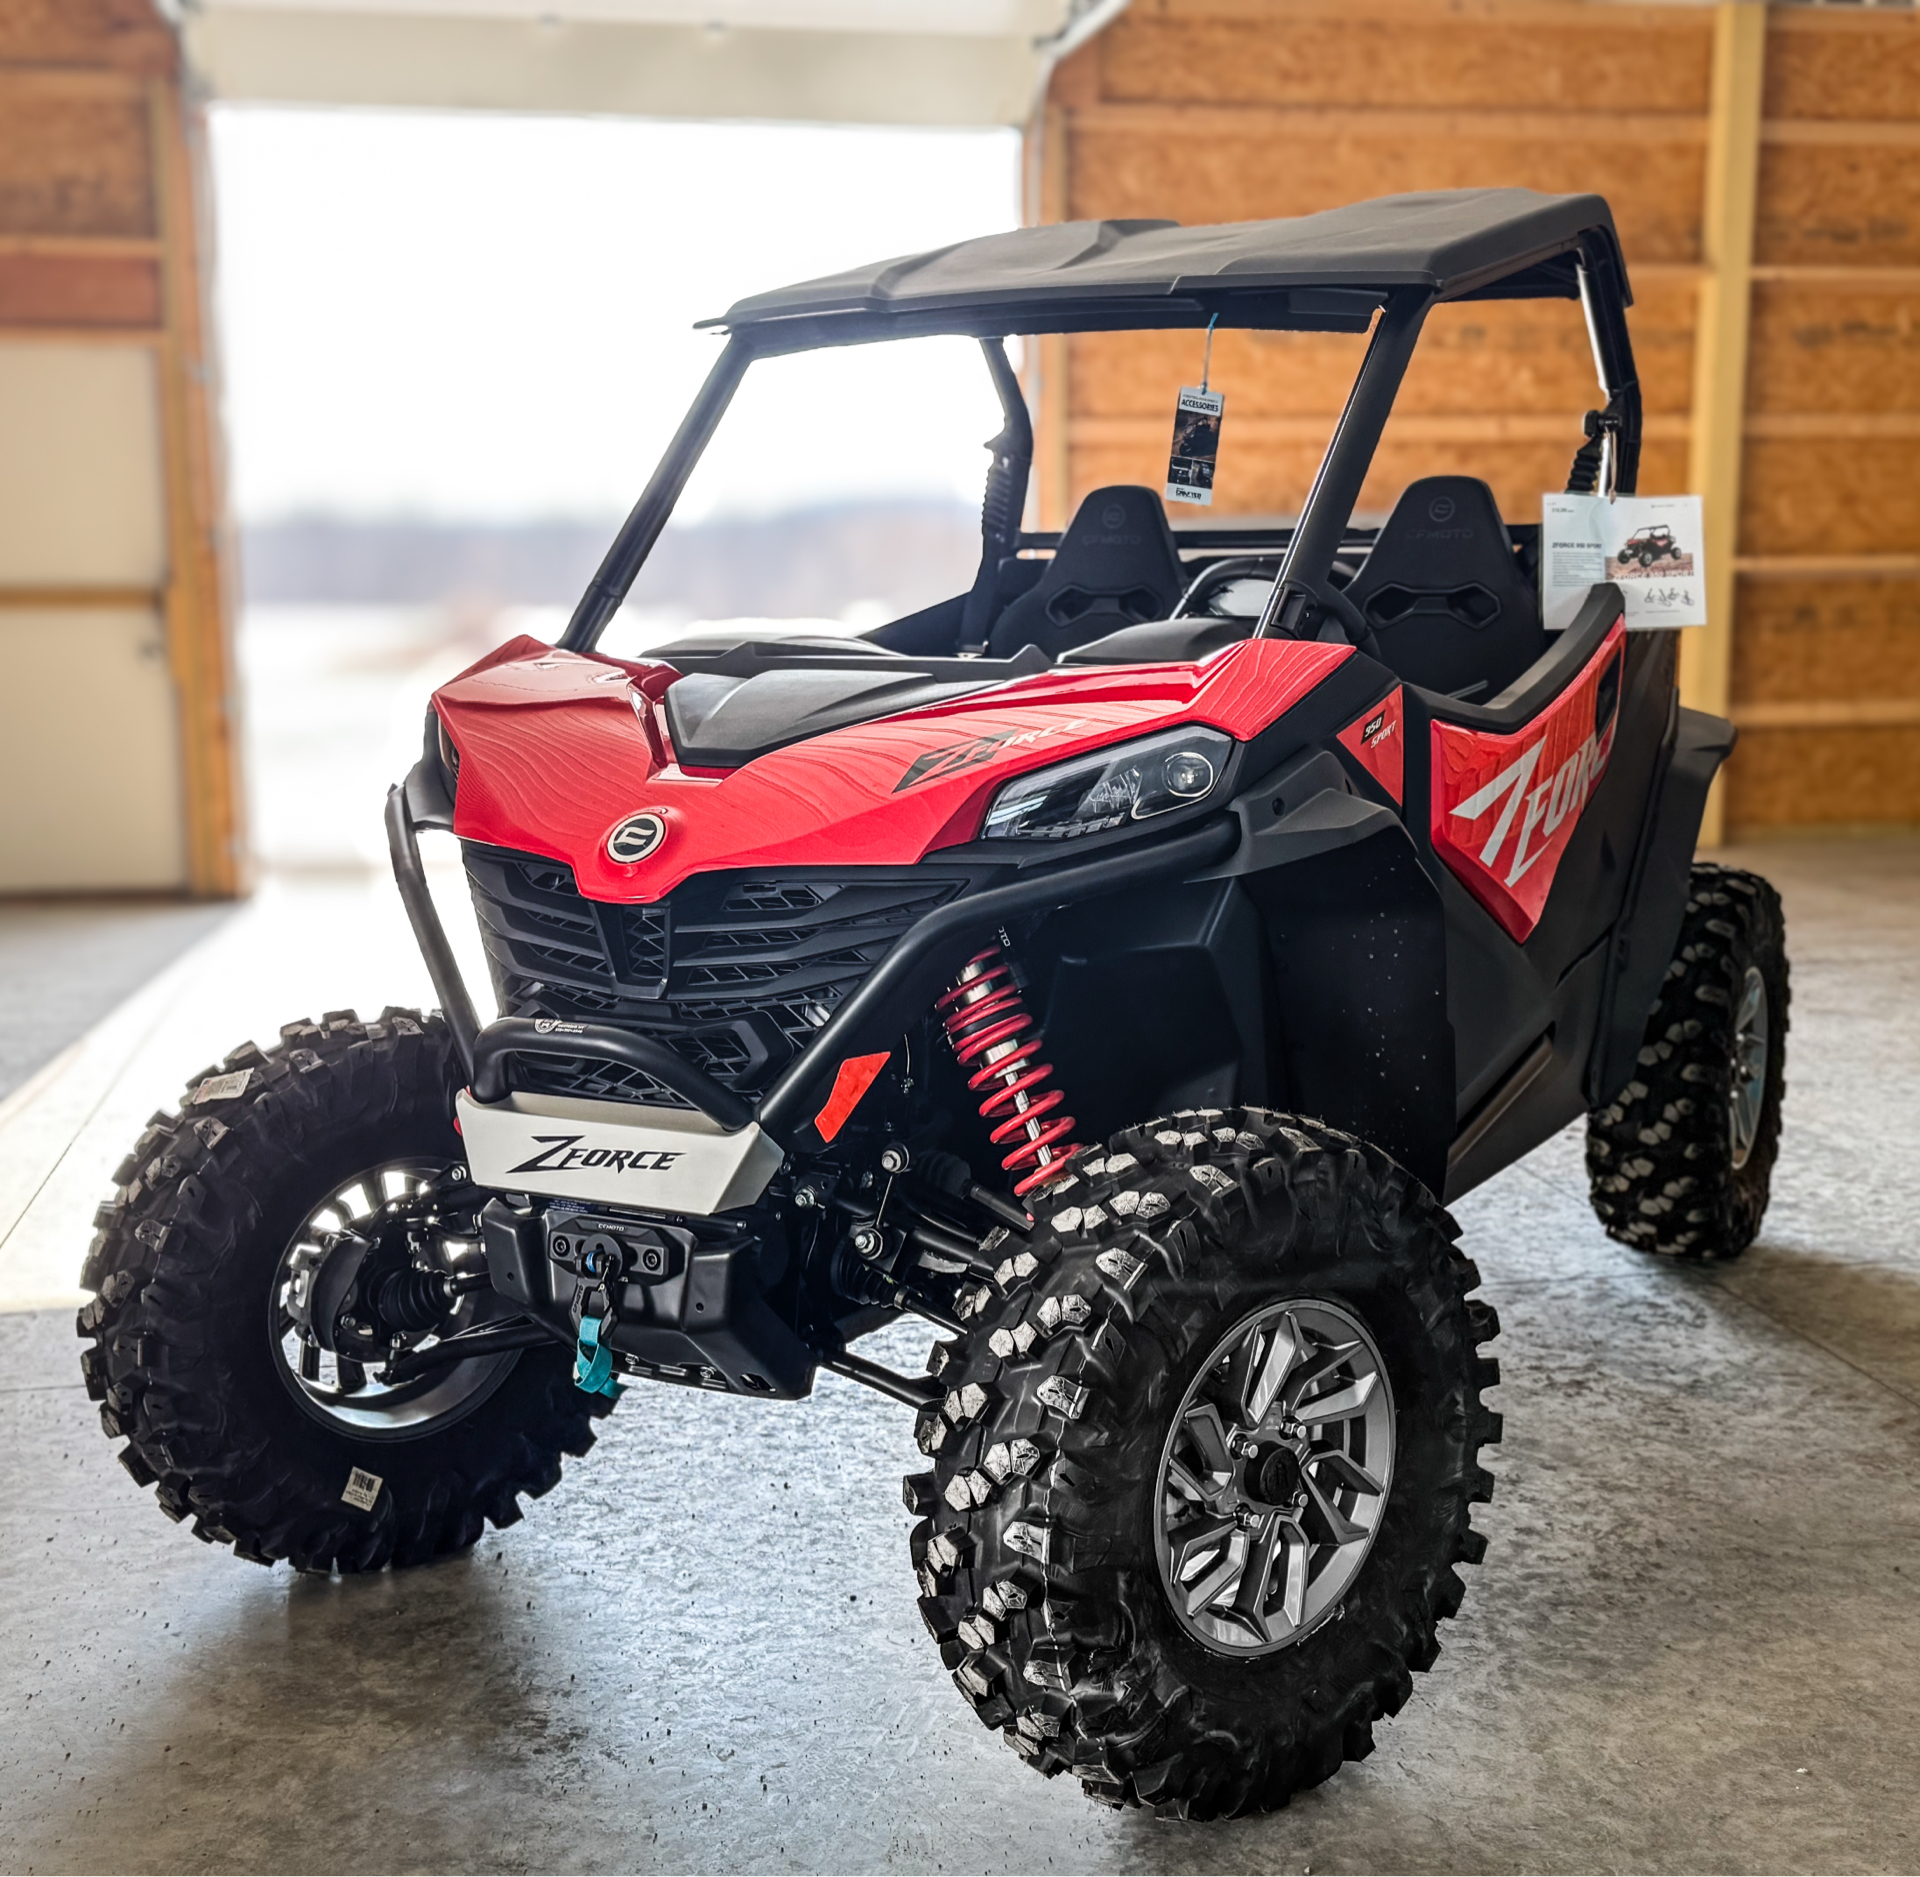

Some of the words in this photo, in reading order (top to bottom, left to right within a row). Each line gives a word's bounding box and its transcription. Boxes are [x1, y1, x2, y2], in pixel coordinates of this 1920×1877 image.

[1181, 398, 1219, 412] ACCESSORIES
[1406, 529, 1474, 539] CFMOTO
[1364, 716, 1383, 738] 950
[1370, 720, 1397, 749] SPORT
[505, 1134, 687, 1175] ZFORCE
